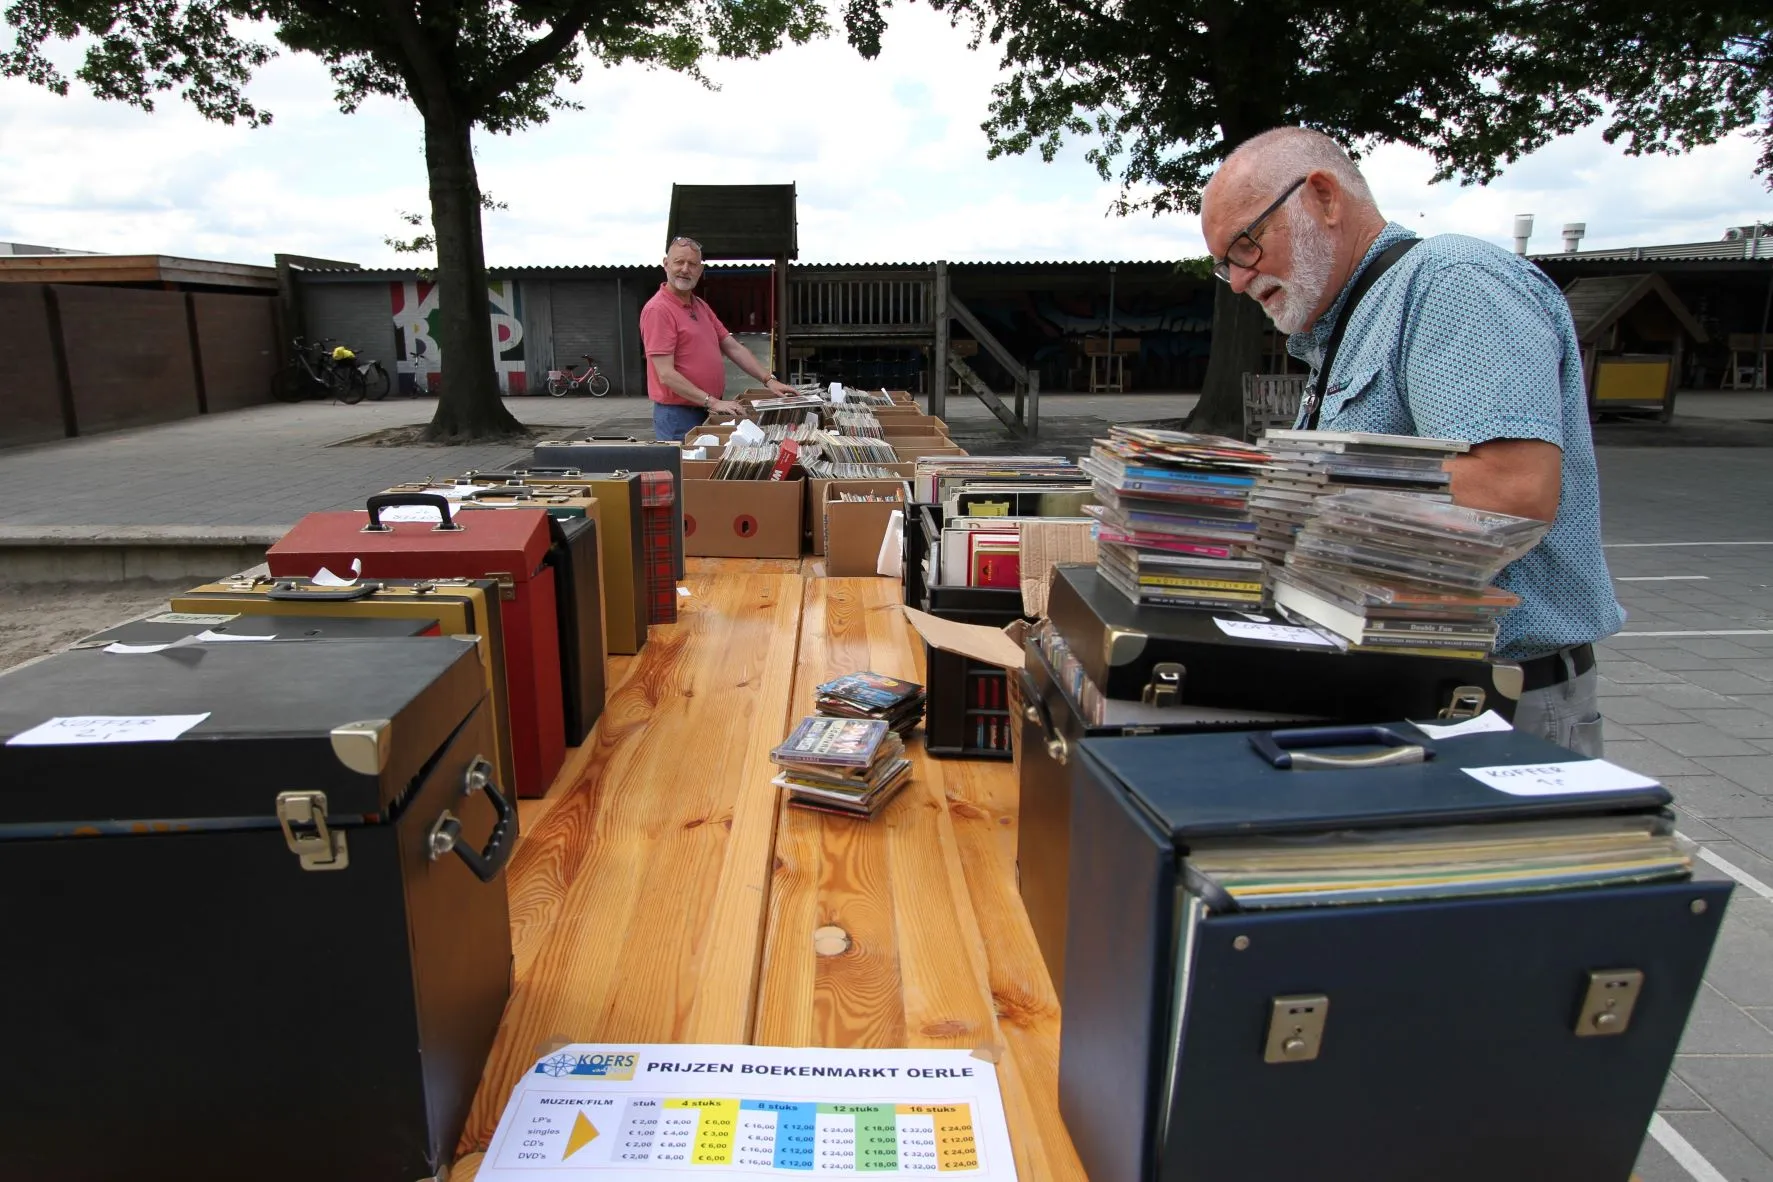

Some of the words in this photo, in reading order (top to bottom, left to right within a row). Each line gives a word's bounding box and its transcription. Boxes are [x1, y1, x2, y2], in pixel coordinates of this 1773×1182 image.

[1486, 766, 1566, 778] KOFFER
[577, 1053, 635, 1067] KOERS
[646, 1061, 734, 1074] PRIJZEN
[741, 1063, 900, 1078] BOEKENMARKT
[906, 1066, 975, 1079] OERLE
[539, 1098, 614, 1106] MUZIEK/FILM
[768, 1103, 799, 1111] stuks
[527, 1128, 560, 1136] singles
[522, 1139, 545, 1147] CD's
[517, 1152, 547, 1160] DVD's
